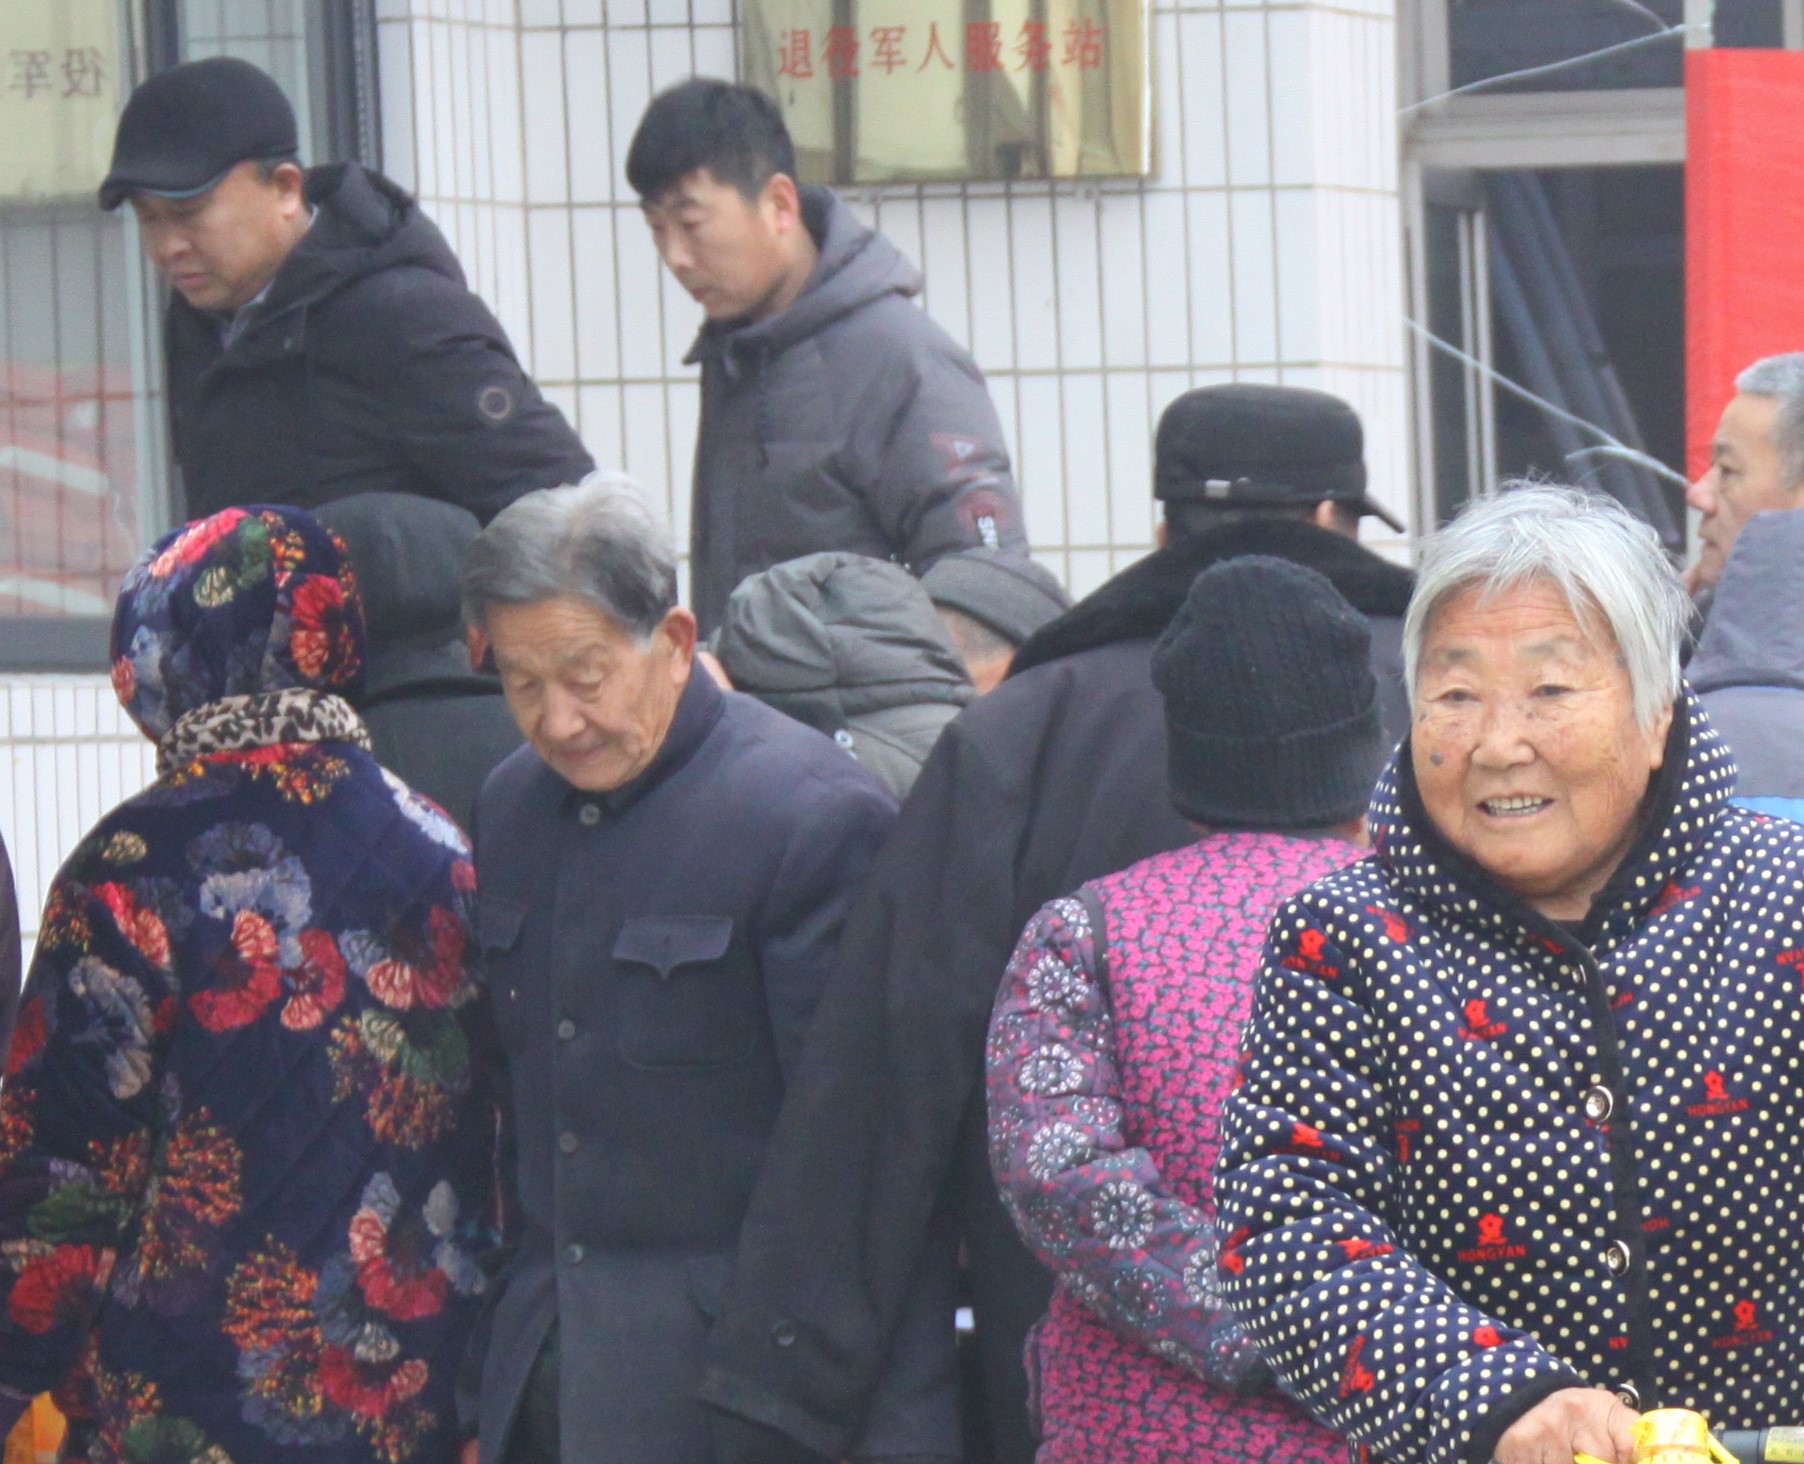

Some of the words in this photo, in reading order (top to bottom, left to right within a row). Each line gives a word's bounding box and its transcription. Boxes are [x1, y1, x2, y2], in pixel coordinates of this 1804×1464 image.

[777, 18, 1104, 79] 退役军人服务站
